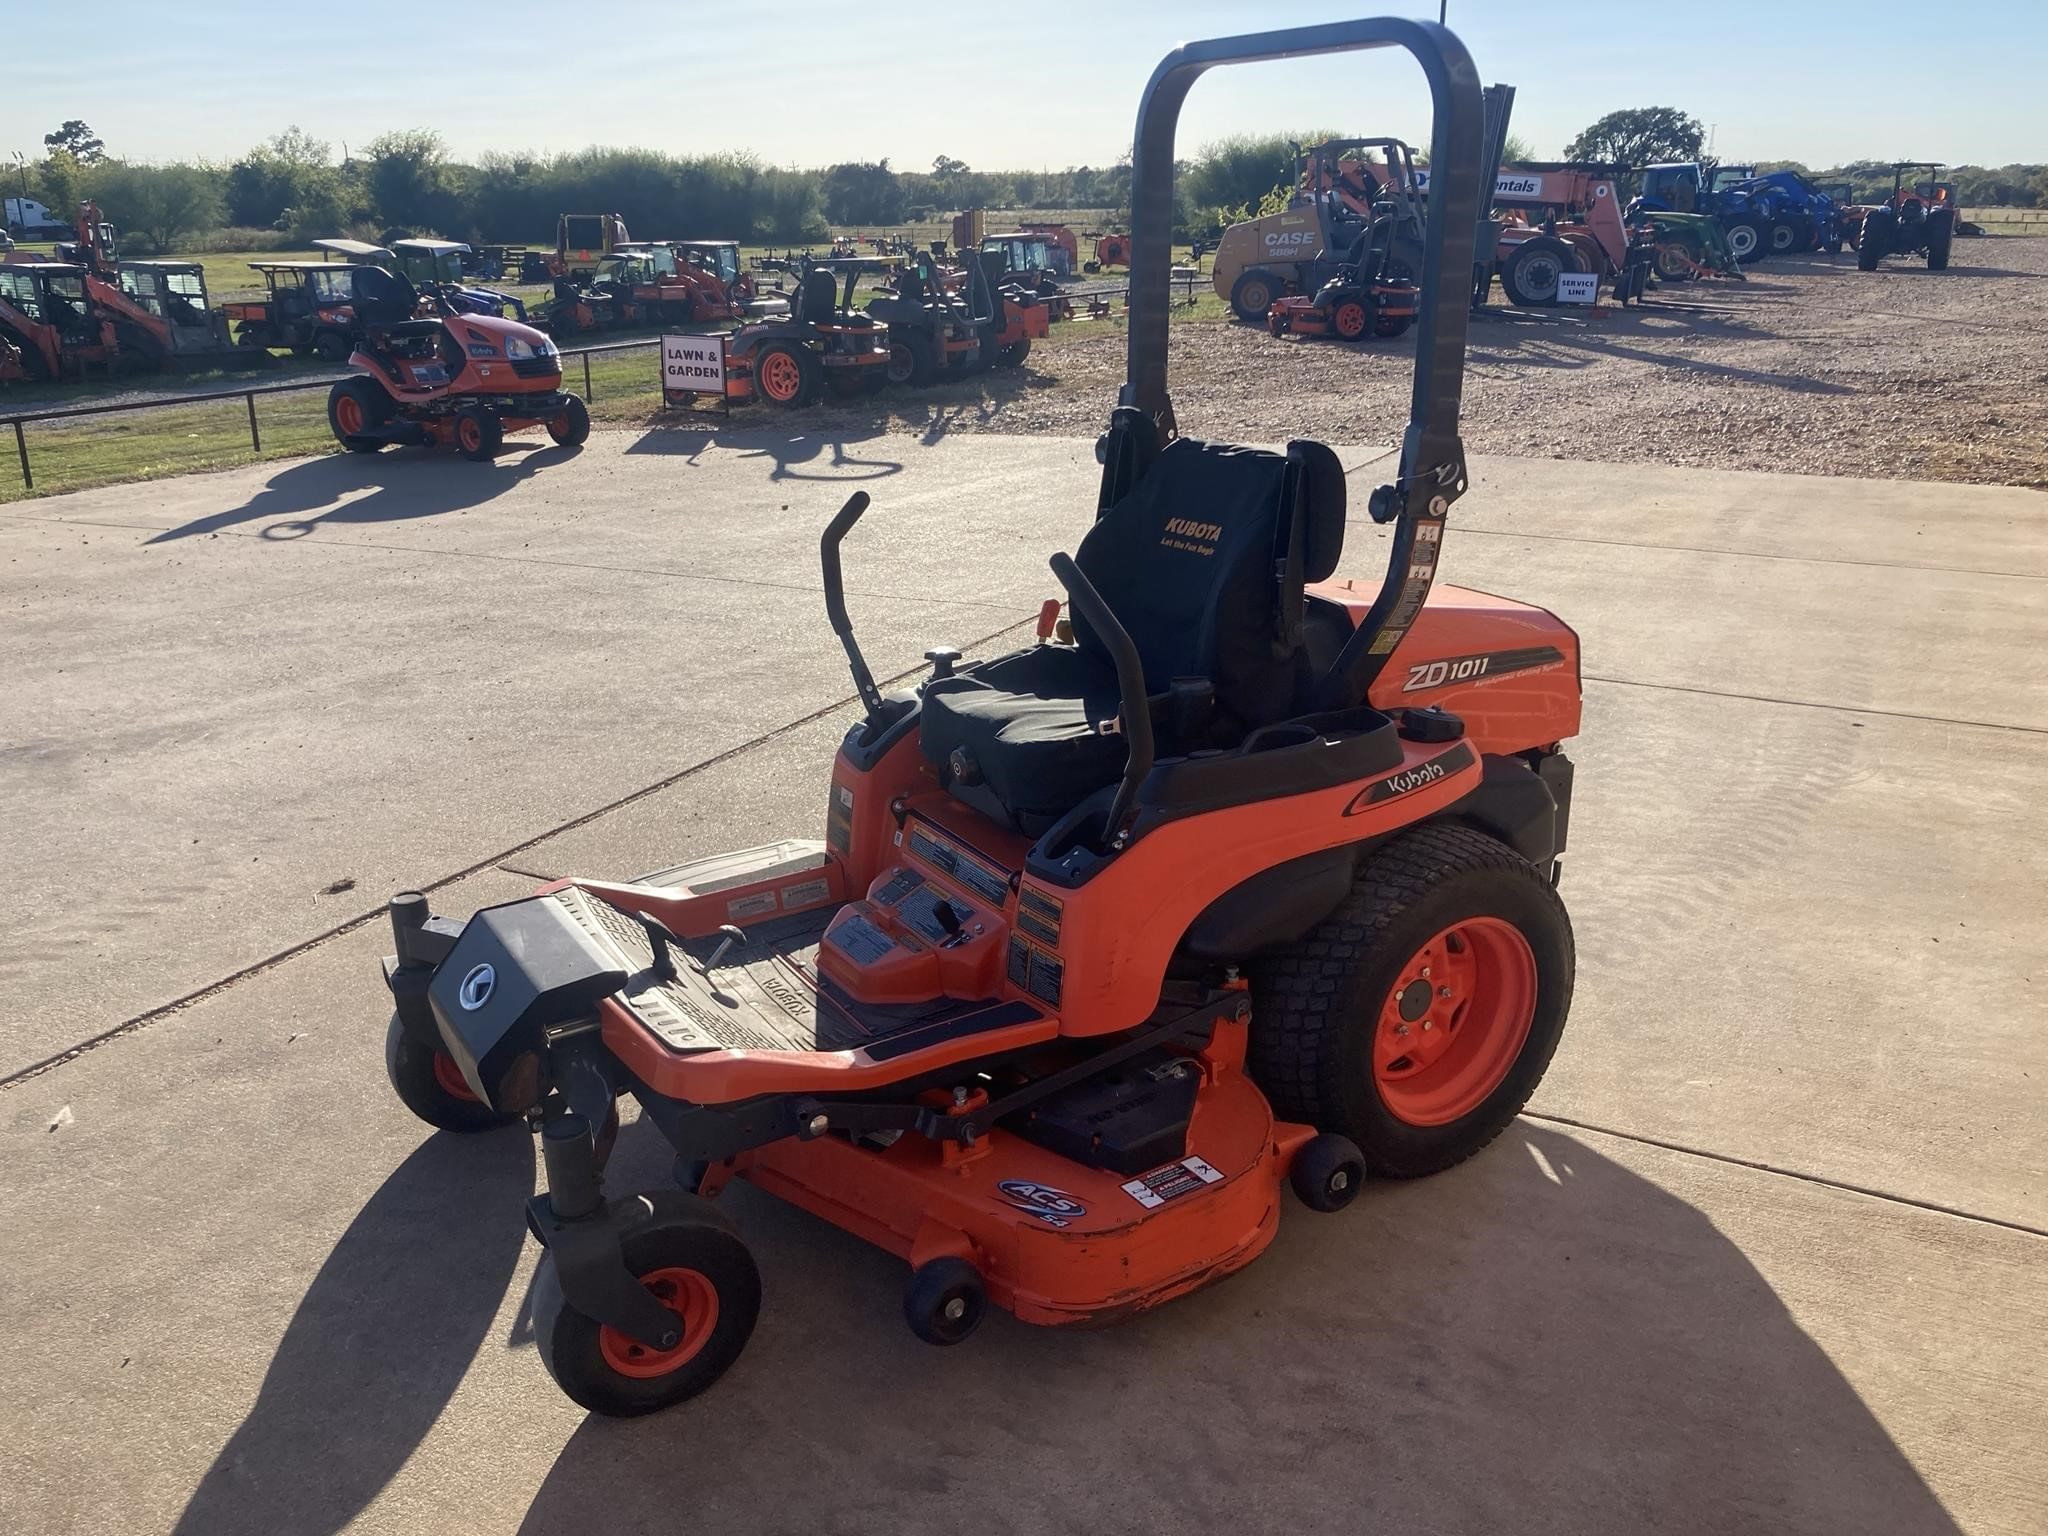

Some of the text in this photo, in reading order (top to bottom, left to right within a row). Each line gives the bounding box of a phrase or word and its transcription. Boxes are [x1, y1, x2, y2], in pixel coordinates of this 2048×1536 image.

[1265, 231, 1316, 246] CASE
[1562, 280, 1594, 288] SERVICE
[1568, 289, 1587, 297] LINE
[668, 349, 718, 362] LAWN &
[668, 365, 719, 378] GARDEN
[1164, 517, 1222, 542] KUBOTA
[1403, 657, 1489, 692] ZD 1011
[1387, 763, 1445, 792] Kubota
[1010, 1184, 1079, 1211] ACS
[1039, 1214, 1070, 1228] 54
